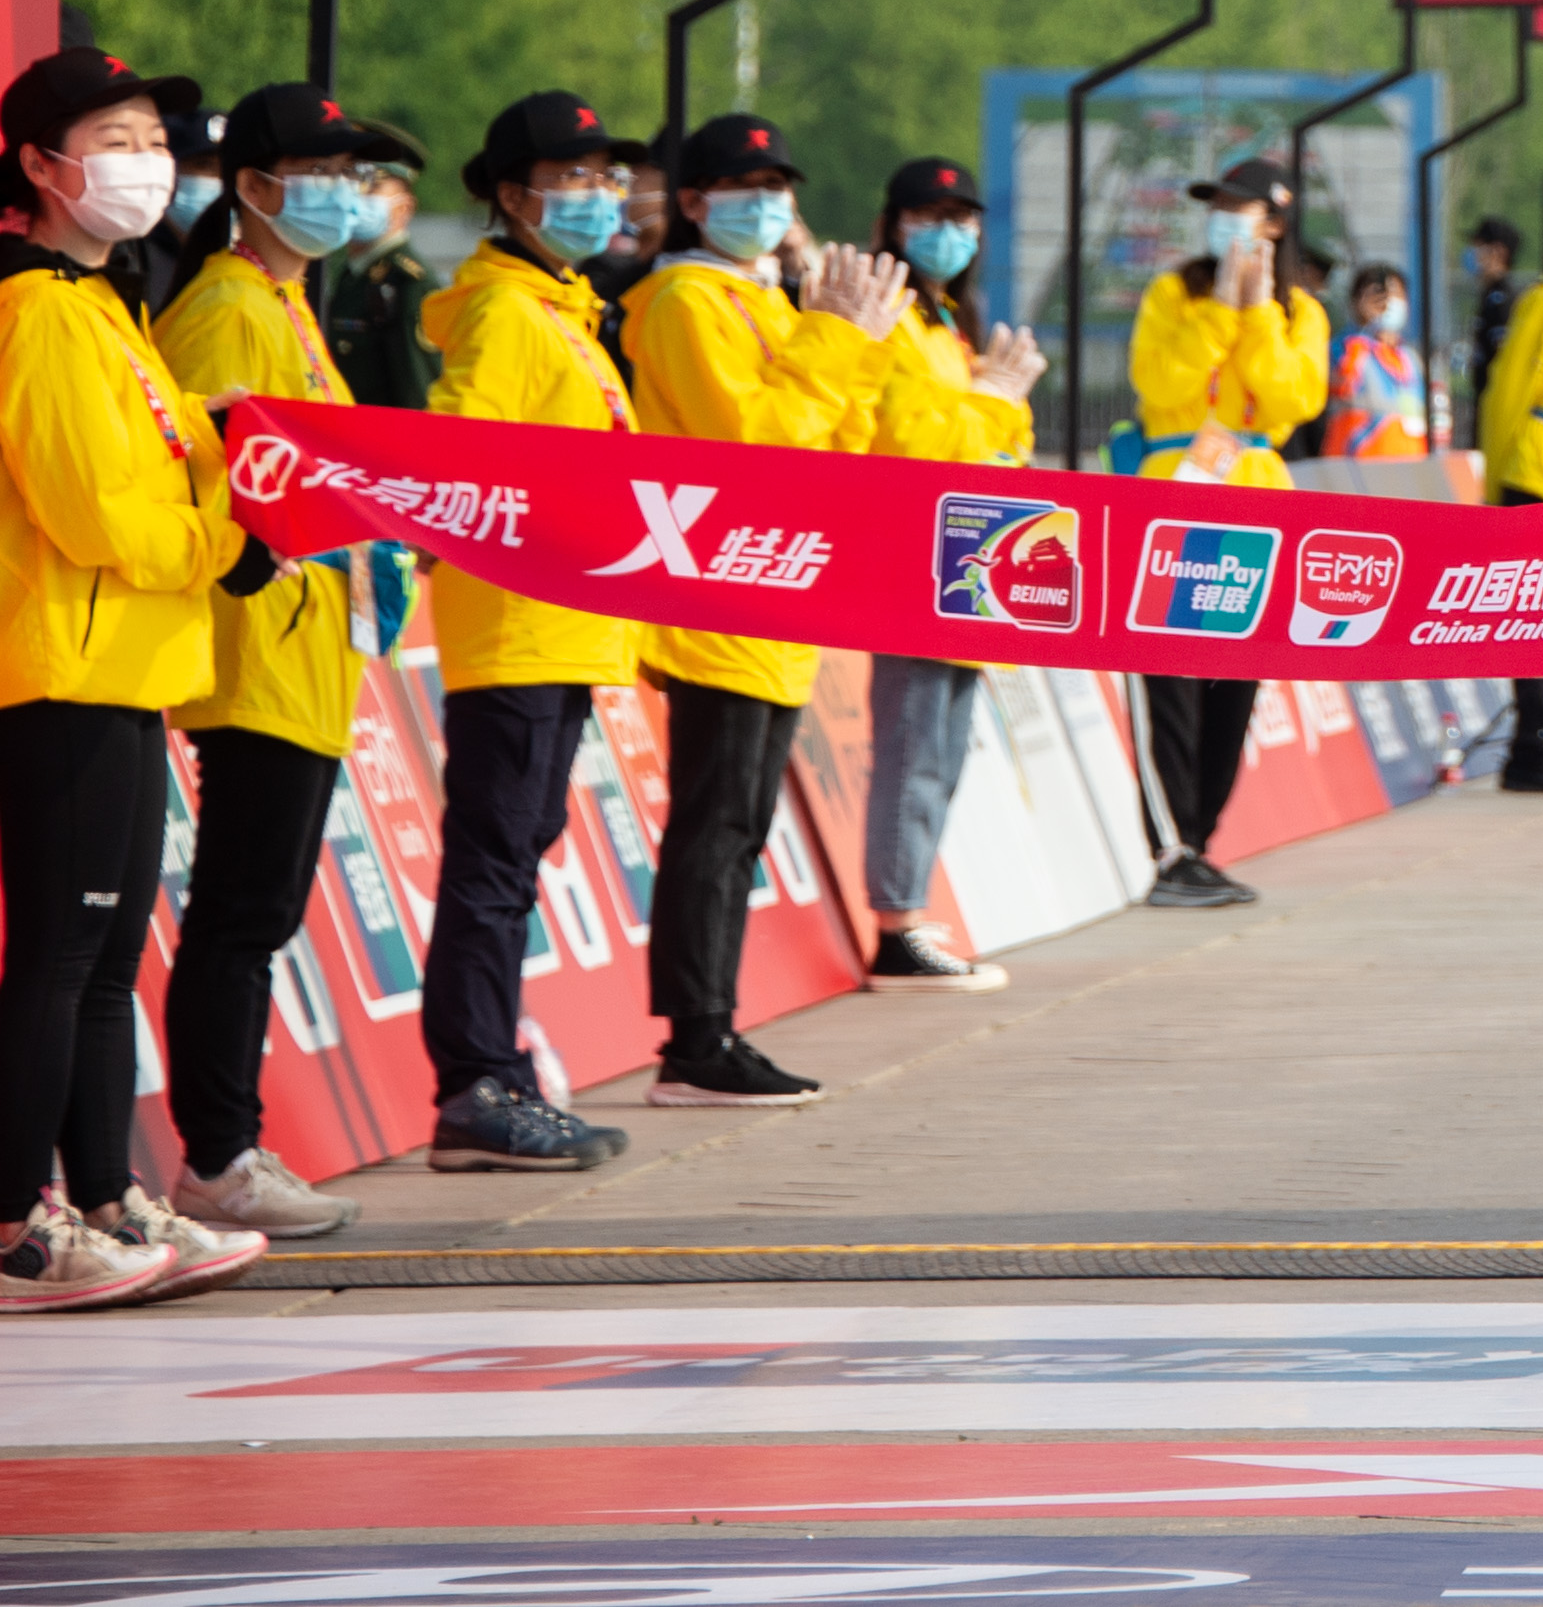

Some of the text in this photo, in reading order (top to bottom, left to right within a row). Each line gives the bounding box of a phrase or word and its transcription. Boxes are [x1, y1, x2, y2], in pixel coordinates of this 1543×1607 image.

[300, 456, 531, 548] 北京现代
[702, 526, 834, 589] 特步
[1150, 549, 1265, 595] UnionPay
[1304, 550, 1396, 588] 云闪付
[1008, 583, 1070, 607] BEIJING
[1190, 583, 1252, 614] 银联
[1319, 587, 1374, 606] UnionPay
[1408, 620, 1491, 645] China
